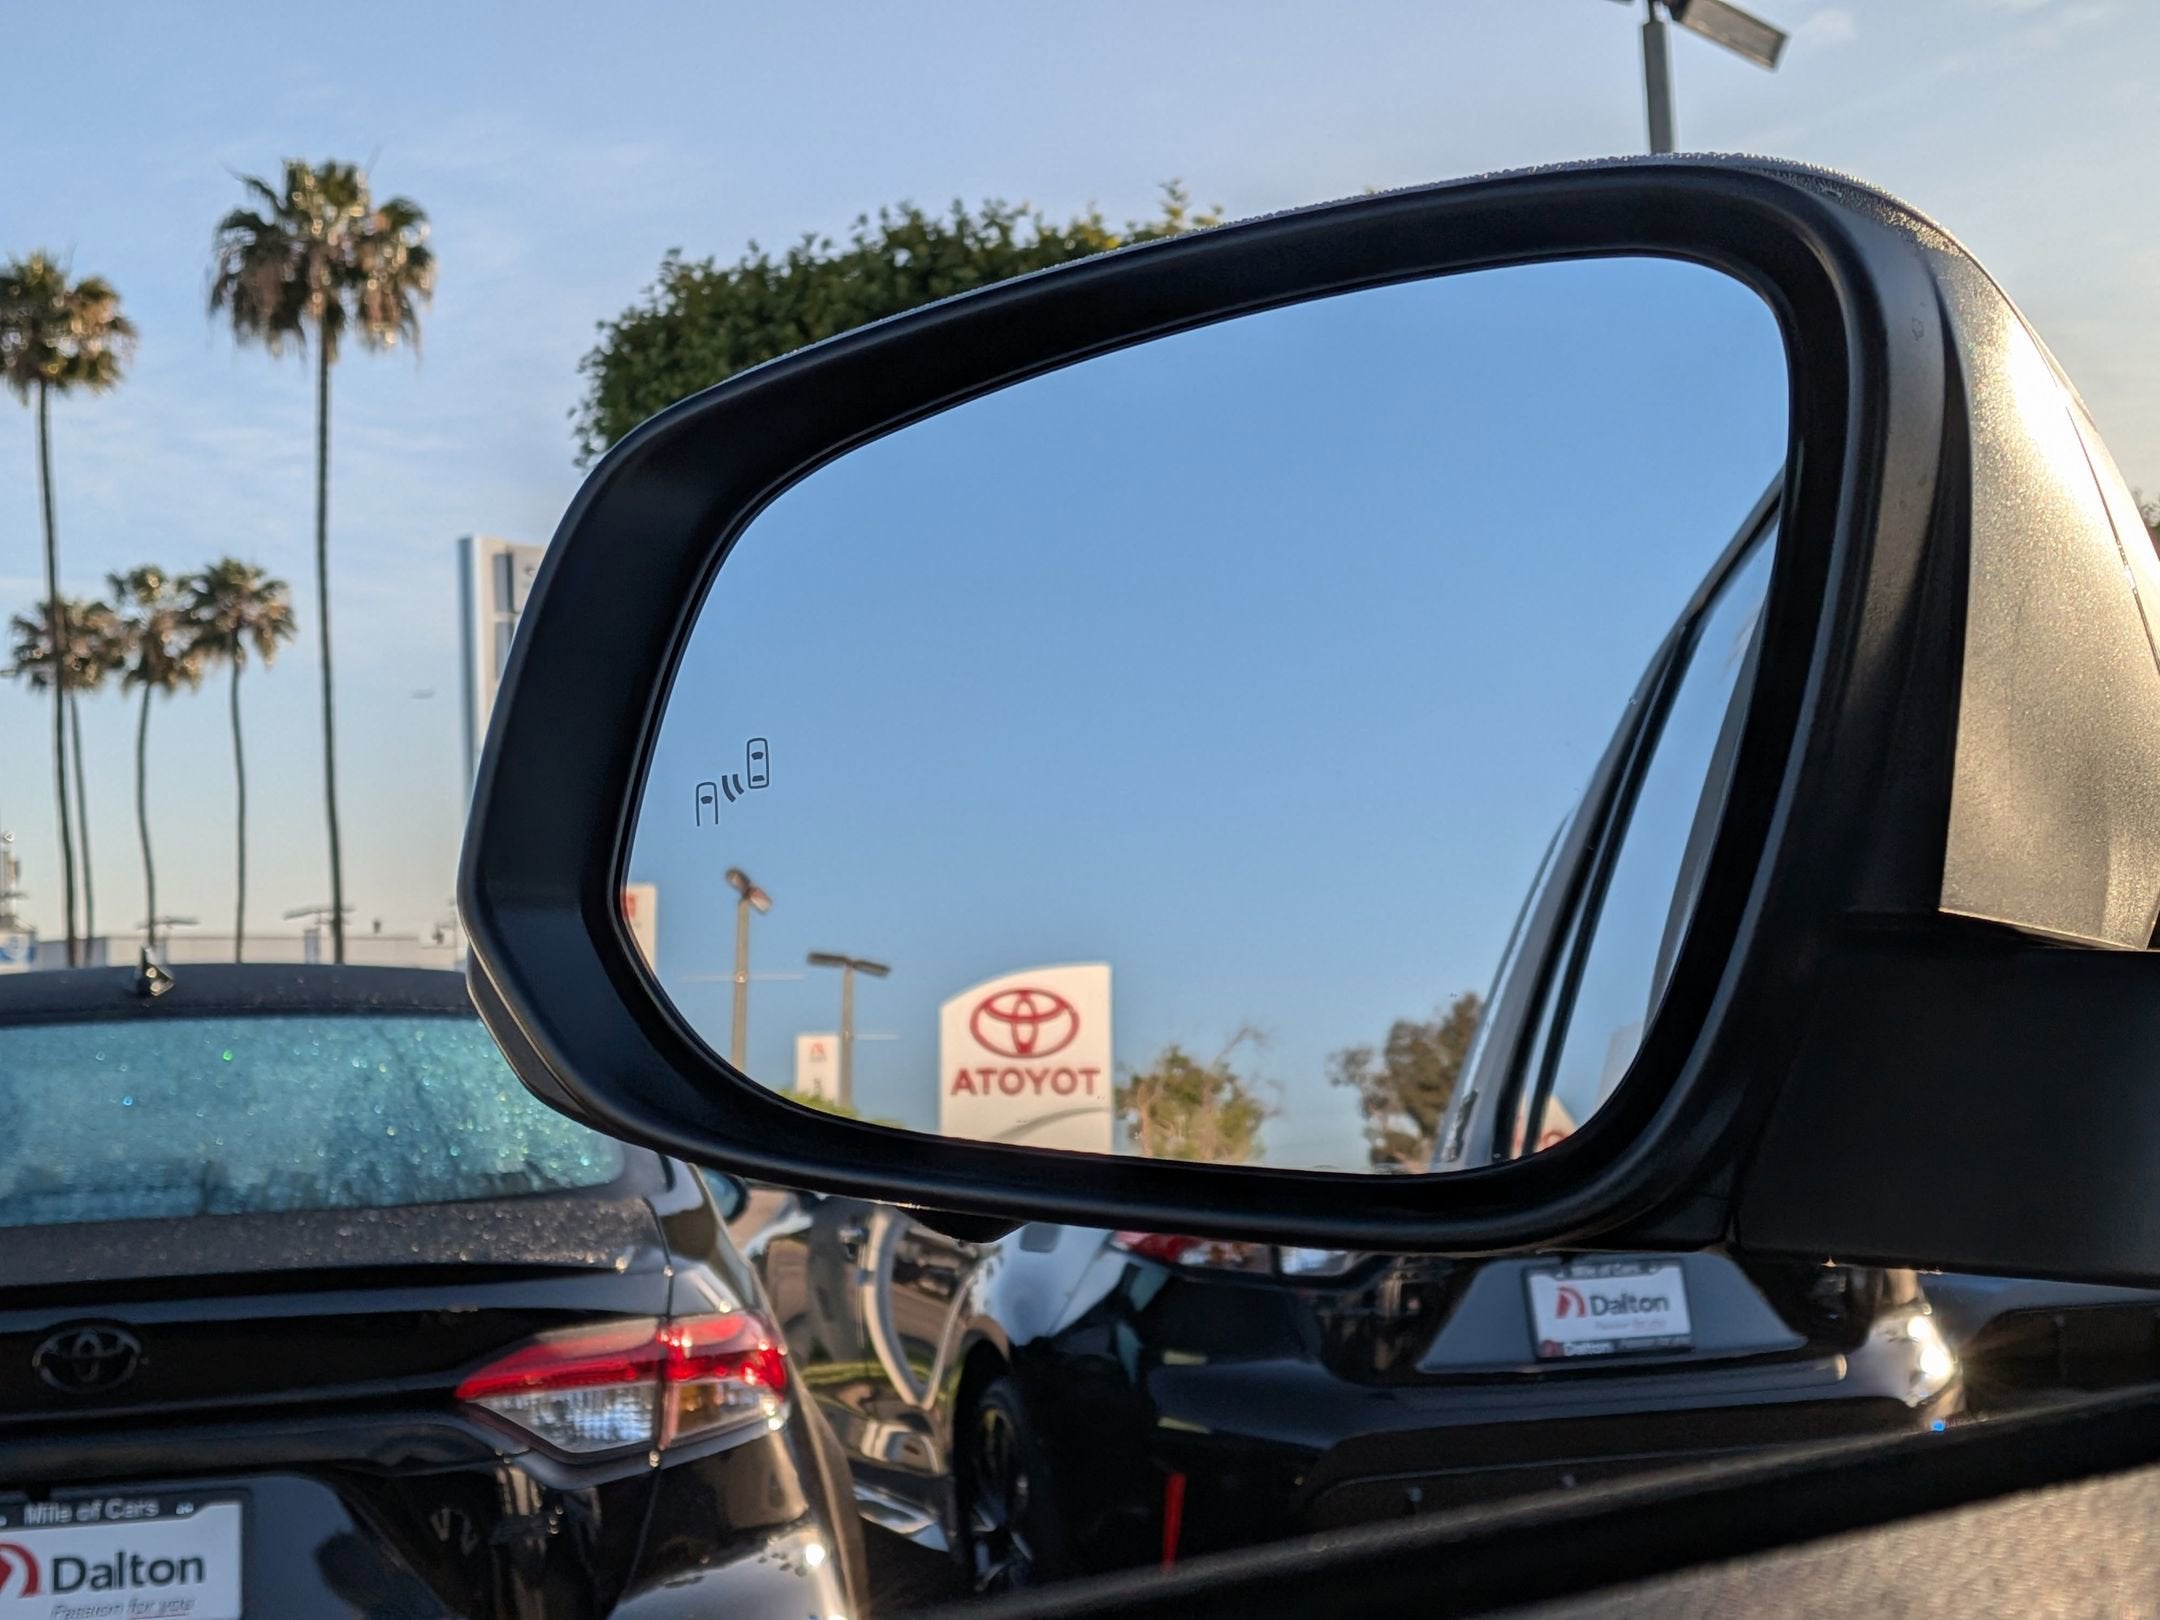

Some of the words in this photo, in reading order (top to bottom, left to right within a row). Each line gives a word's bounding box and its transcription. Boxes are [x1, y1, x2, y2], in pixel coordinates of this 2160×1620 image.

[1590, 1291, 1669, 1316] Dalton
[24, 1503, 73, 1526] Mile
[76, 1500, 101, 1521] of
[105, 1498, 160, 1519] Cars
[52, 1550, 206, 1594] Dalton
